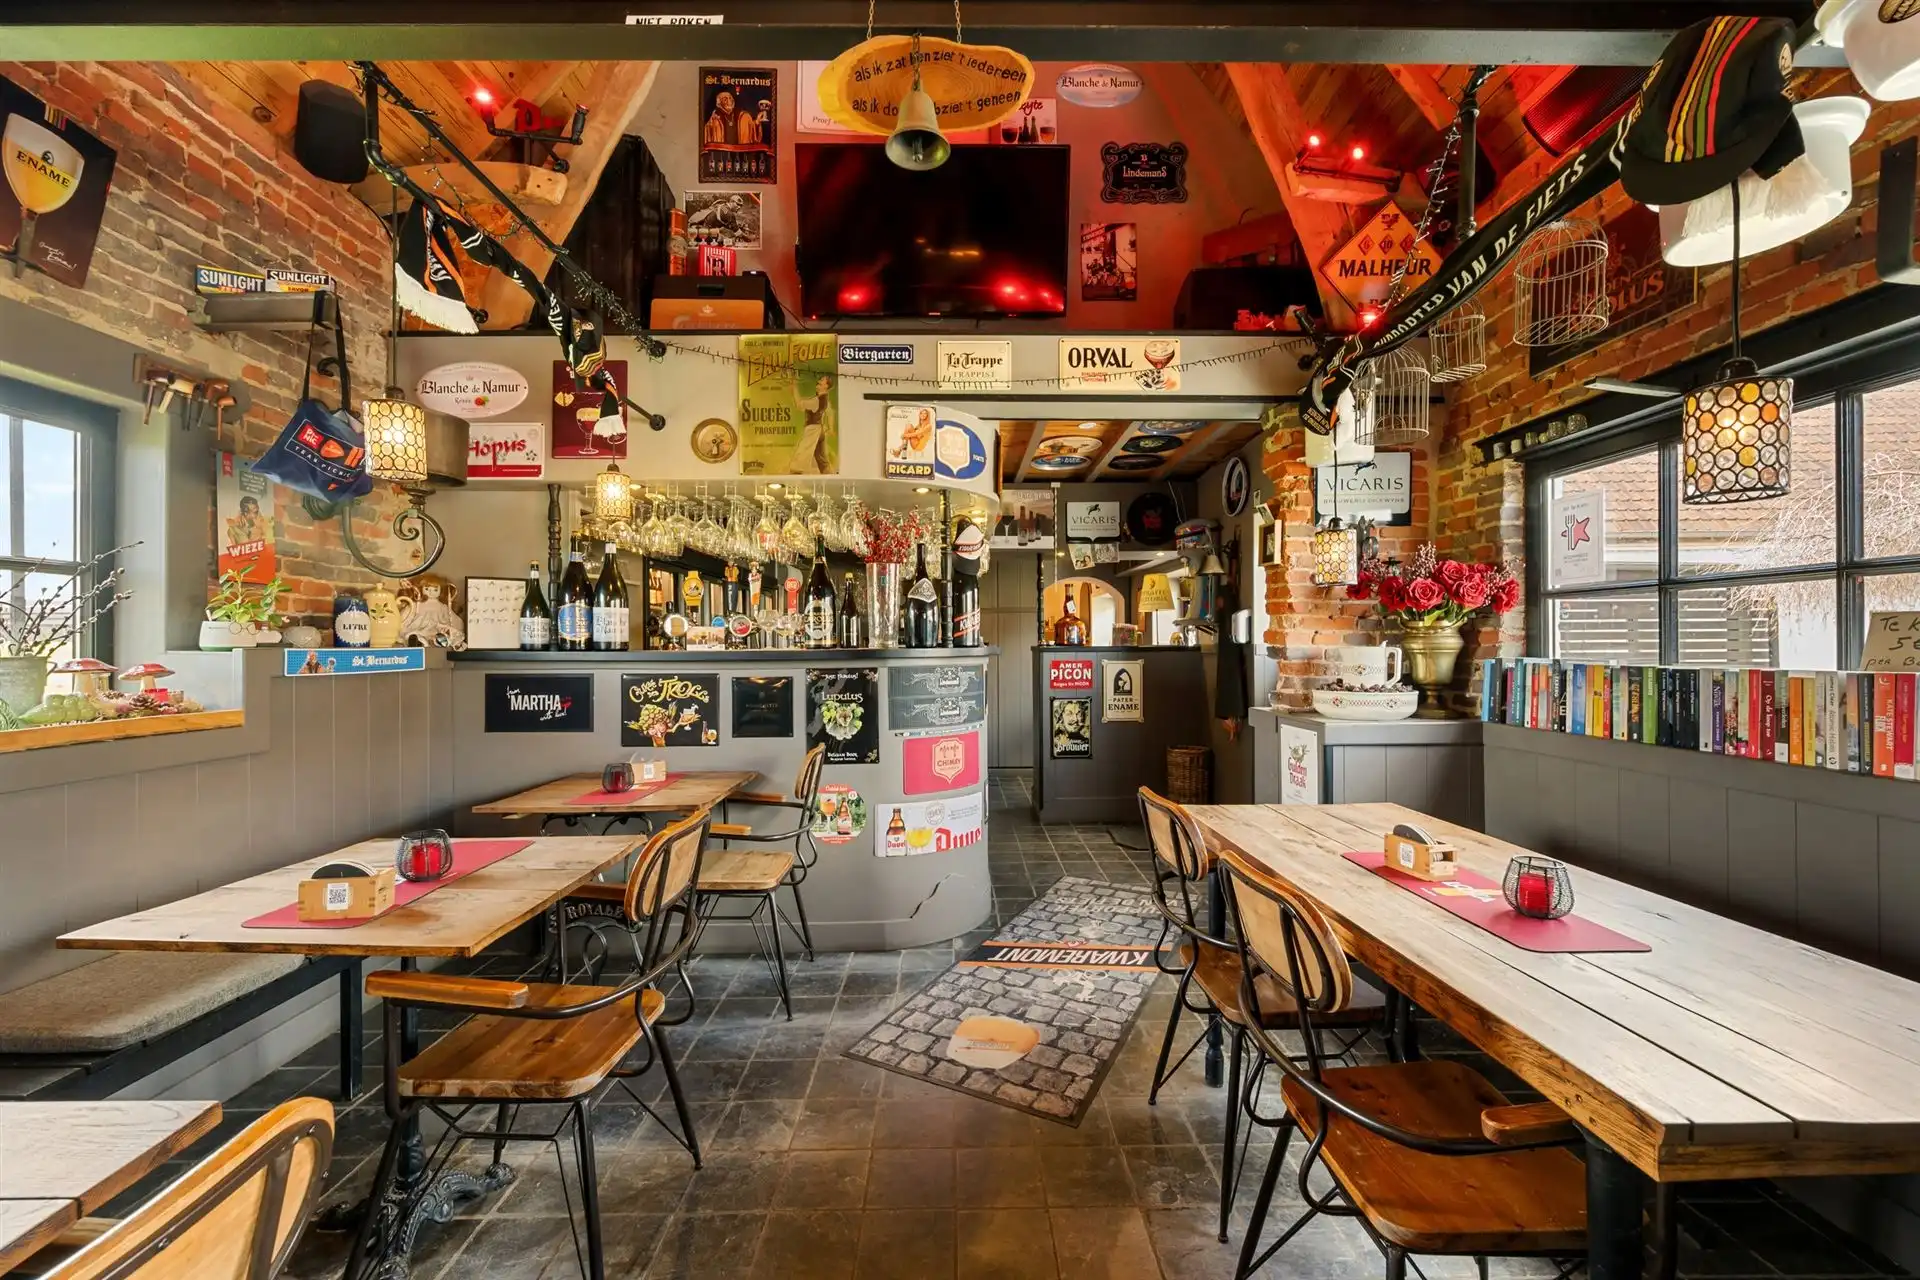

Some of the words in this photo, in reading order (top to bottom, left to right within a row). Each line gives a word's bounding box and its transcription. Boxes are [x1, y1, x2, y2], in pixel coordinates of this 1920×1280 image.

[855, 66, 871, 82] als
[872, 60, 883, 76] ik
[886, 57, 906, 72] zat
[933, 50, 955, 62] ziet
[967, 57, 1027, 83] iedereen
[722, 75, 771, 86] Bernardus
[1061, 77, 1100, 89] Blanche
[1110, 77, 1140, 89] Namur
[852, 98, 868, 113] als
[870, 96, 880, 114] ik
[977, 90, 1022, 113] geneen
[16, 150, 72, 189] ENAME
[1446, 255, 1488, 298] VAN
[1525, 152, 1588, 230] FIETS
[1338, 257, 1433, 279] MALHEUR
[199, 269, 264, 292] SUNLIGHT
[269, 270, 326, 284] SUNLIGHT
[843, 348, 911, 362] Biergarten
[944, 352, 961, 370] La
[961, 352, 1004, 369] Trappe
[1068, 347, 1133, 368] ORVAL
[420, 380, 469, 395] Blanche
[472, 384, 481, 393] de
[482, 380, 521, 394] Namur
[888, 464, 932, 475] RICARD
[1326, 477, 1404, 491] VICARIS
[1072, 516, 1117, 525] VICARIS
[229, 541, 265, 557] WIEZE
[1880, 615, 1900, 632] Te
[1908, 617, 1920, 631] K
[366, 654, 409, 667] Bernardus
[1051, 669, 1092, 680] PICON
[510, 694, 562, 712] MARTHA
[1108, 703, 1140, 711] ENAME
[1886, 699, 1894, 716] KATE
[1885, 717, 1894, 751] STEWART
[988, 947, 1150, 966] KWAREMONT
